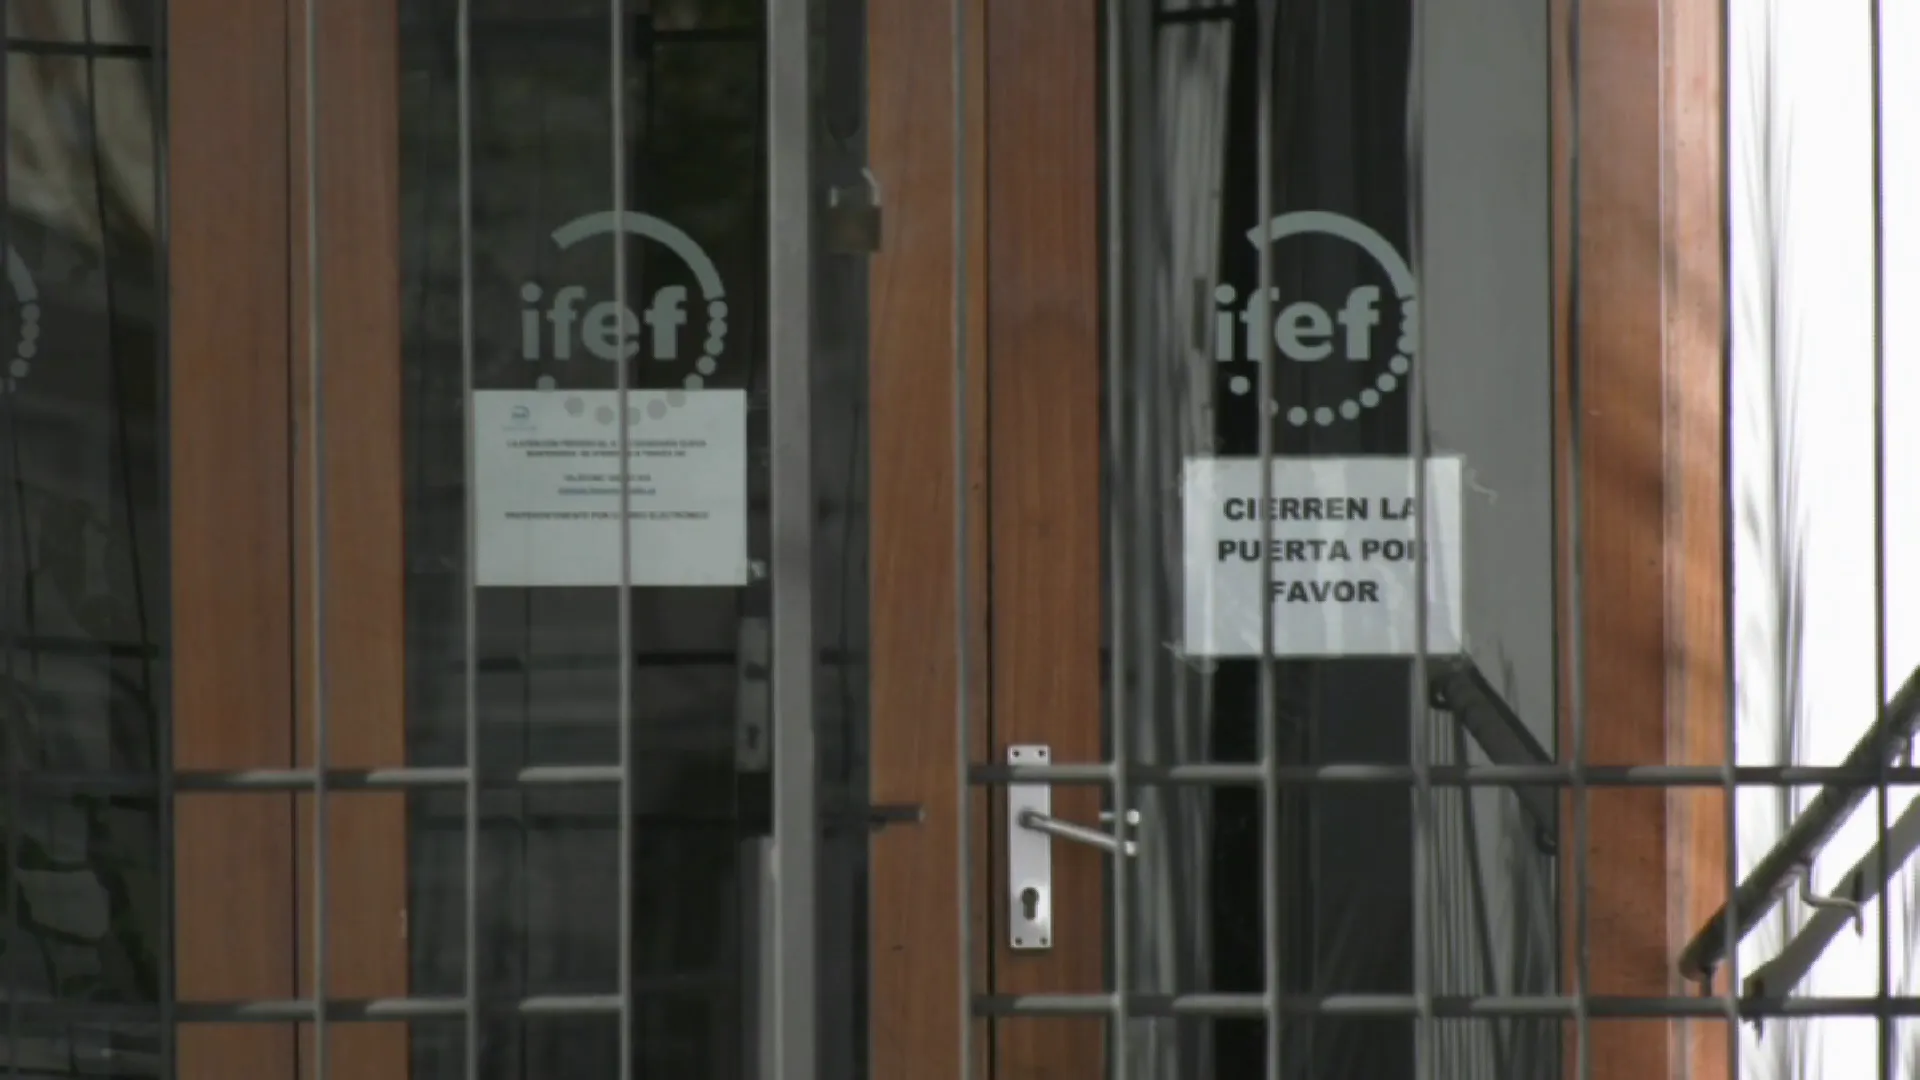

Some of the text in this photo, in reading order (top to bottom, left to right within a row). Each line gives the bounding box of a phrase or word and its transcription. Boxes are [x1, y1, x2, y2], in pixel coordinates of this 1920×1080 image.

[520, 282, 688, 361] ifef
[1214, 284, 1381, 362] ifef
[1223, 497, 1369, 521] CIERREN
[1218, 539, 1351, 562] PUERTA
[1269, 580, 1380, 603] FAVOR
